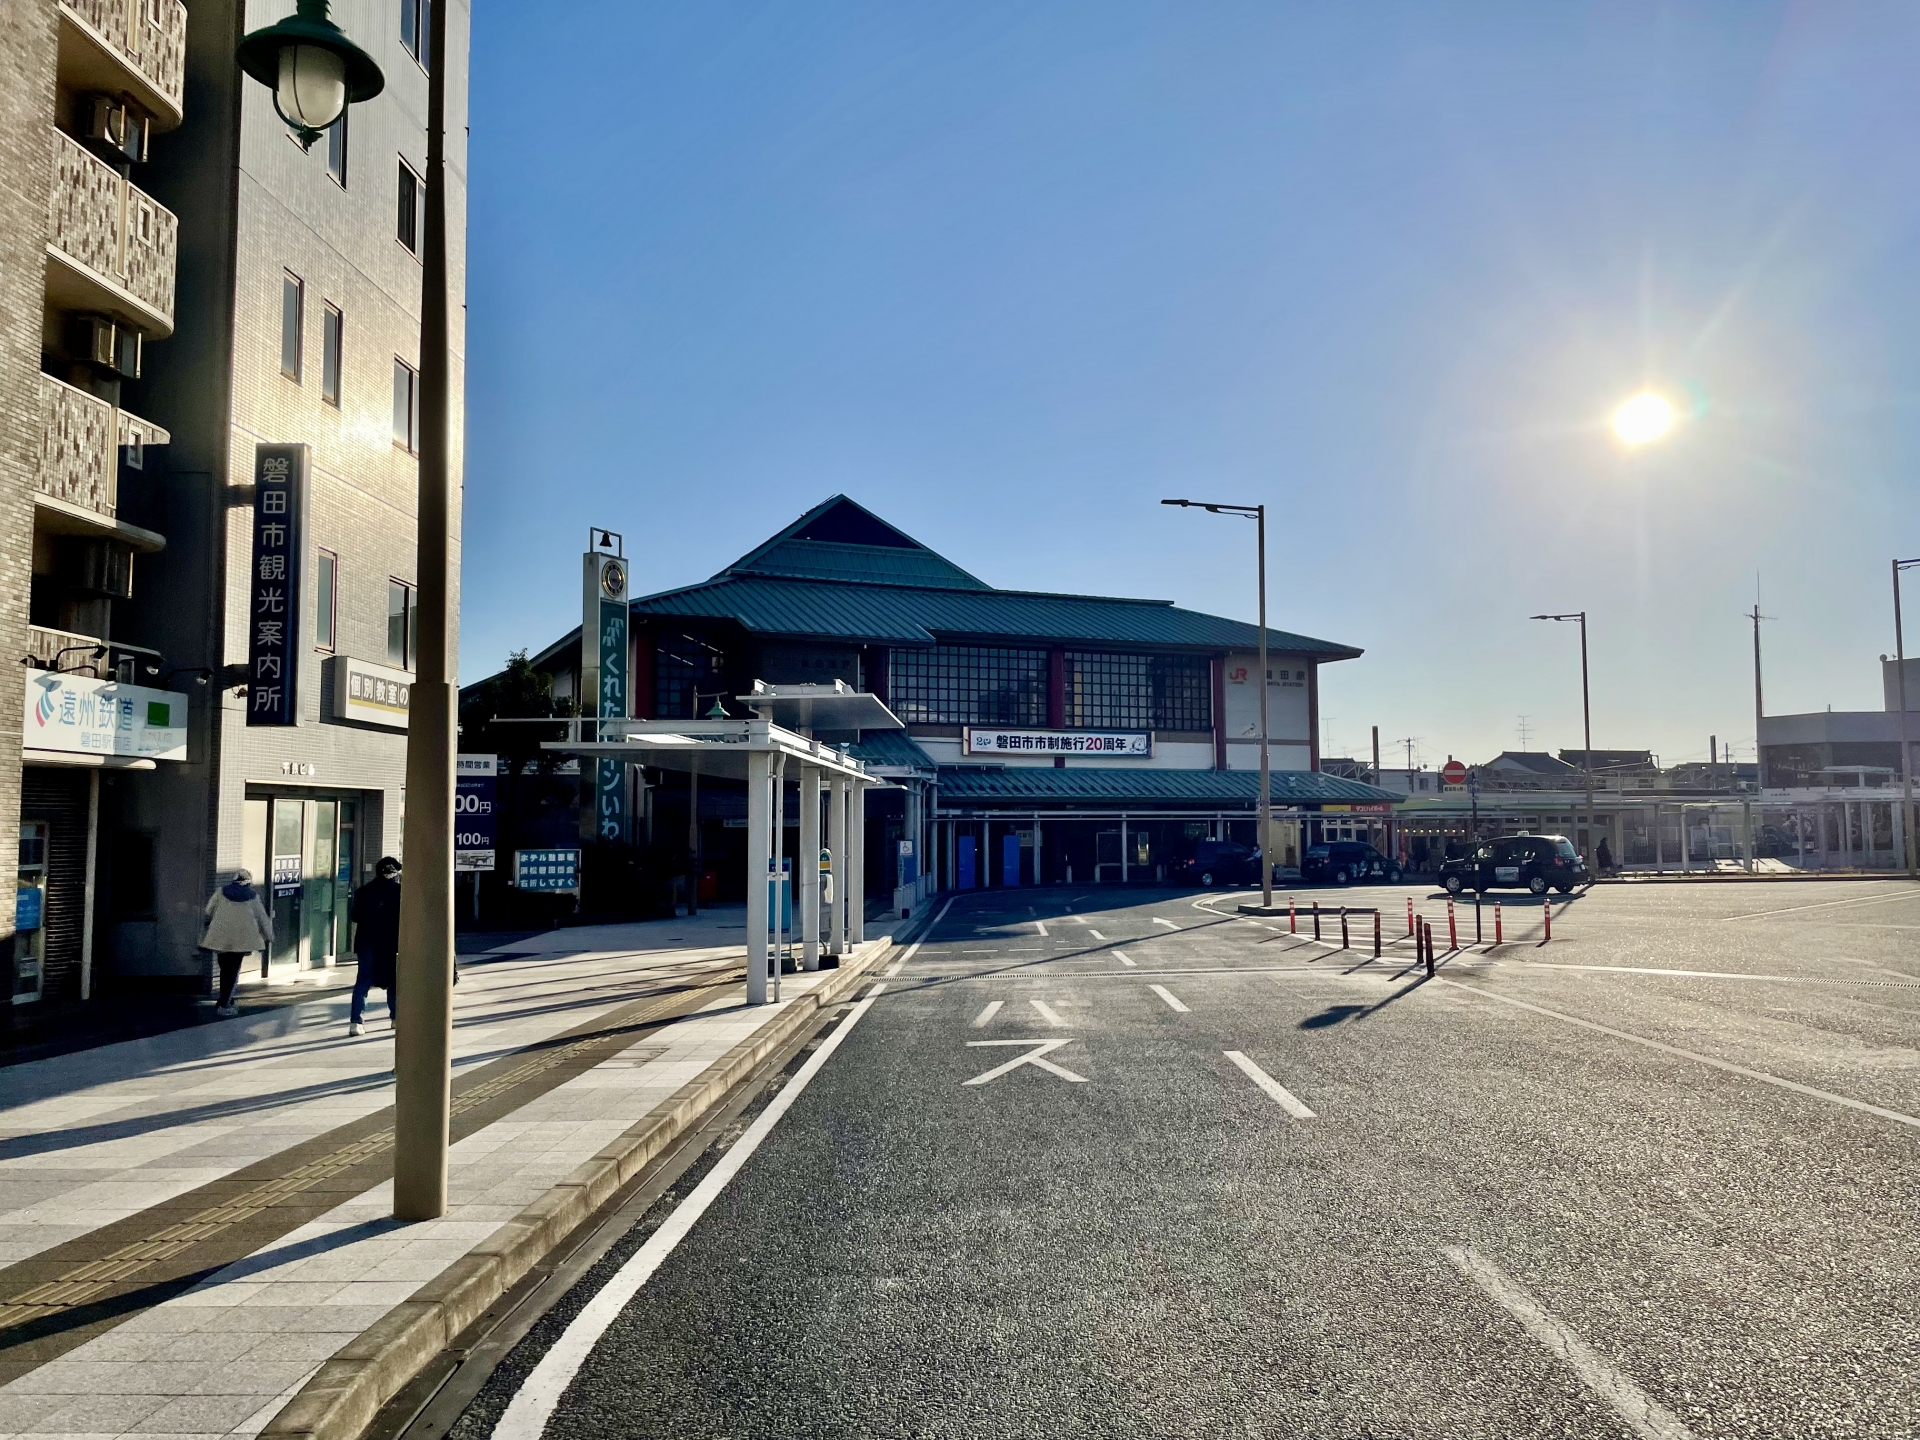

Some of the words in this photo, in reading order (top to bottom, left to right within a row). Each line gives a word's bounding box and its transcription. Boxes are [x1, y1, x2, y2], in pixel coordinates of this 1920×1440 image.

[254, 457, 289, 711] 磐田市観光案内所
[1230, 668, 1247, 680] JR
[351, 674, 408, 705] 個別教室の
[59, 688, 133, 731] 遠州鉄道
[996, 735, 1126, 751] 磐田市市制施行20周年
[520, 878, 575, 887] 右折してすぐ
